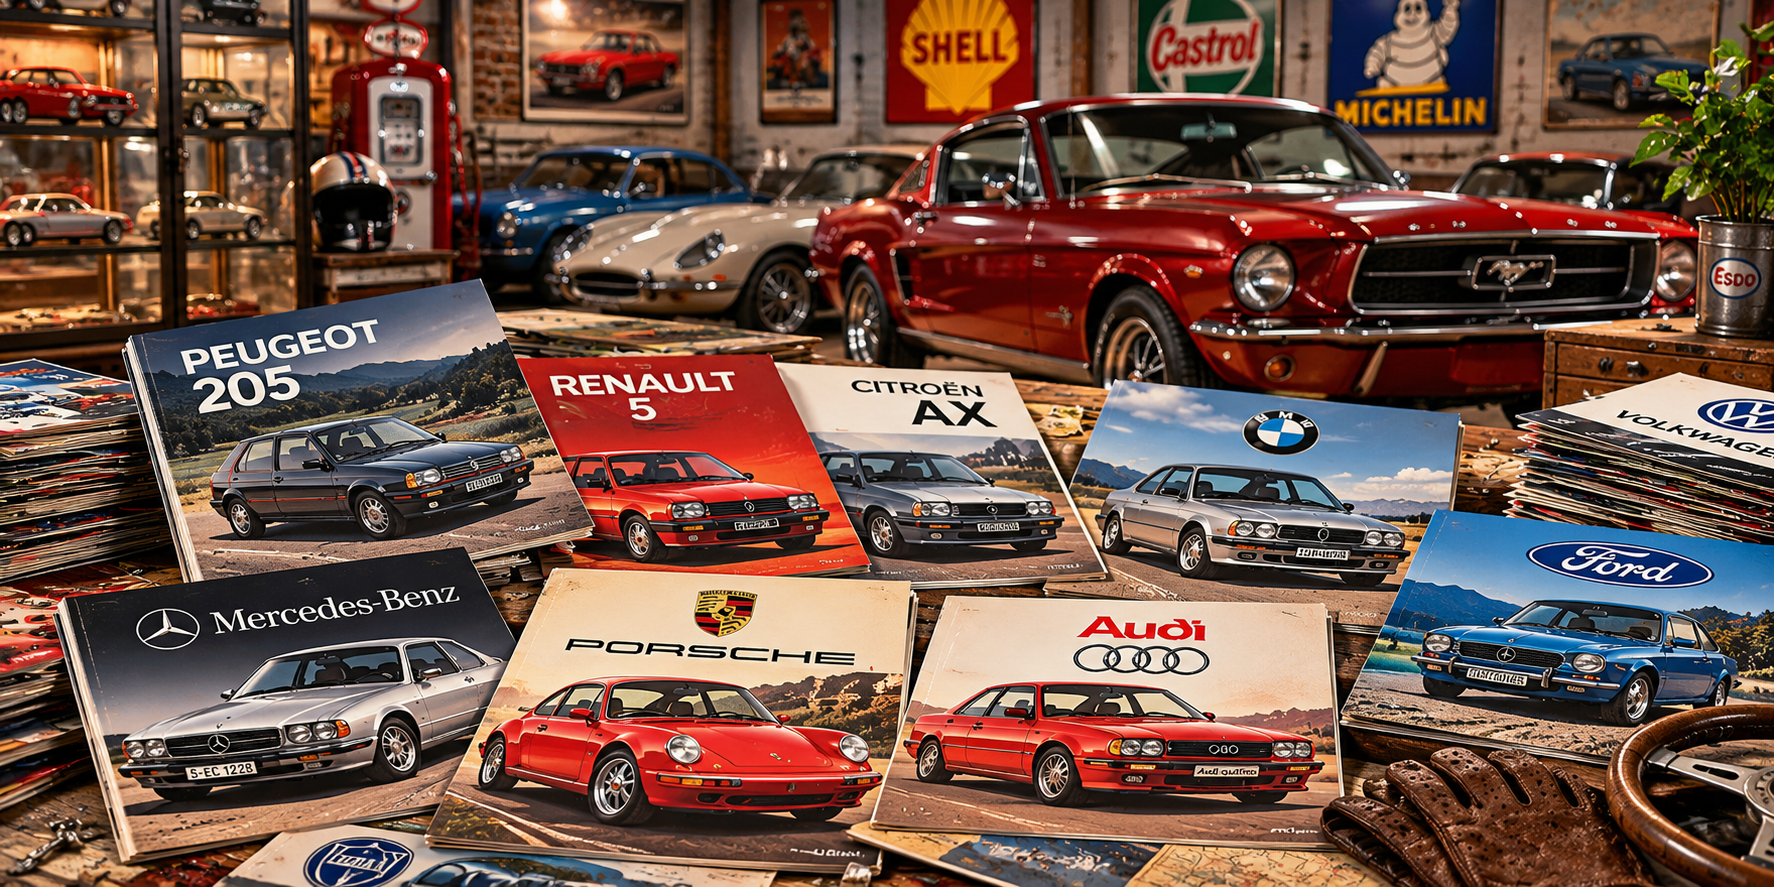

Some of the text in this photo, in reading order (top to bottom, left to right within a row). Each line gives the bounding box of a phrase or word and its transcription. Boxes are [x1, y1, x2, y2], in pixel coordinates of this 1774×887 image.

[913, 31, 1008, 64] SHELL
[1152, 21, 1259, 72] Castrol
[1335, 97, 1487, 126] MICHELIN
[180, 319, 378, 375] PEUGEOT
[193, 364, 300, 414] 205
[549, 371, 735, 396] RENAULT
[851, 380, 983, 397] CITROËN
[628, 397, 657, 421] 5
[912, 400, 998, 428] AX
[1616, 410, 1774, 459] VOLKWAGE
[1561, 545, 1680, 582] Ford
[209, 586, 460, 634] Mercedes-Benz
[1077, 616, 1206, 641] Audi
[565, 638, 855, 665] PORSCHE
